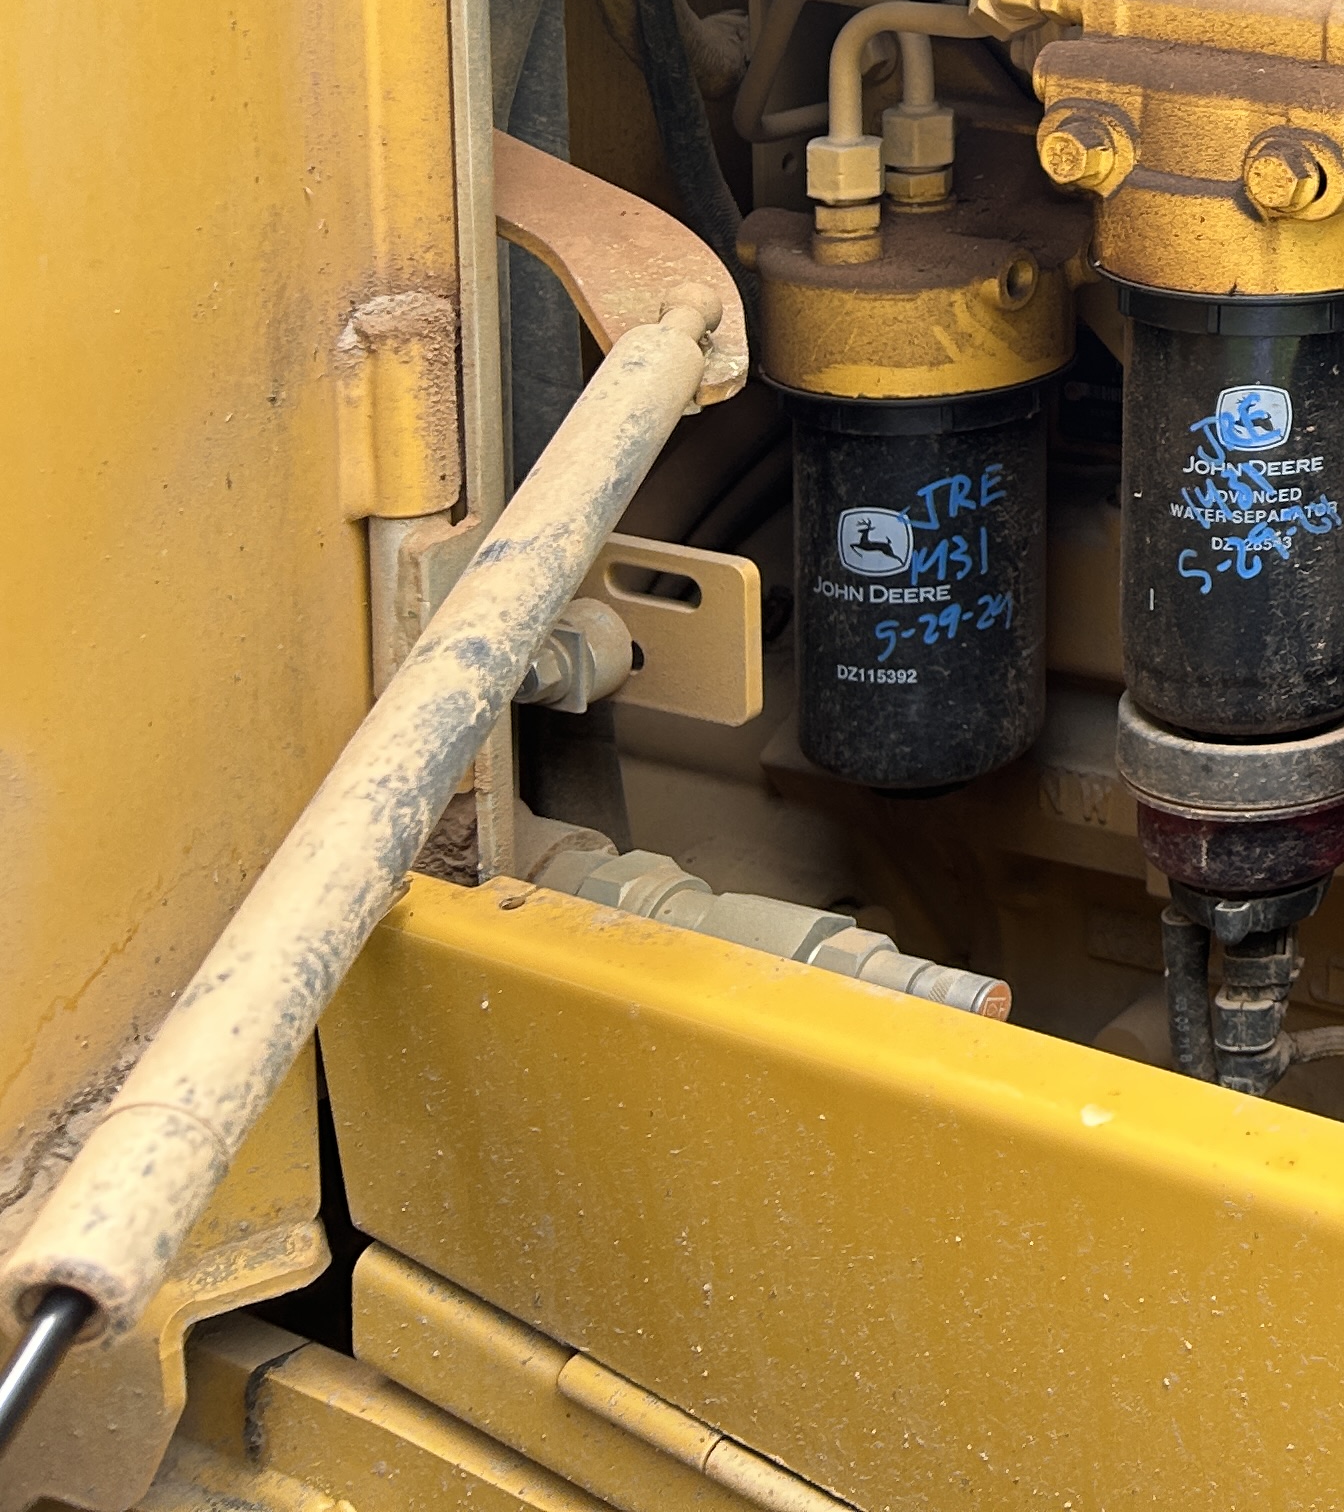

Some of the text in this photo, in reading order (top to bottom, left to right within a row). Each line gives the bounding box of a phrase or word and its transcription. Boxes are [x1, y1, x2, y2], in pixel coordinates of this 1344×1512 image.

[1182, 455, 1325, 478] JOHN DEERE
[897, 463, 1008, 531] JRE
[1202, 487, 1303, 505] ADVNCED
[1169, 502, 1230, 524] WATER
[813, 575, 952, 605] JOHN DEERE
[836, 663, 919, 685] DZ115392
